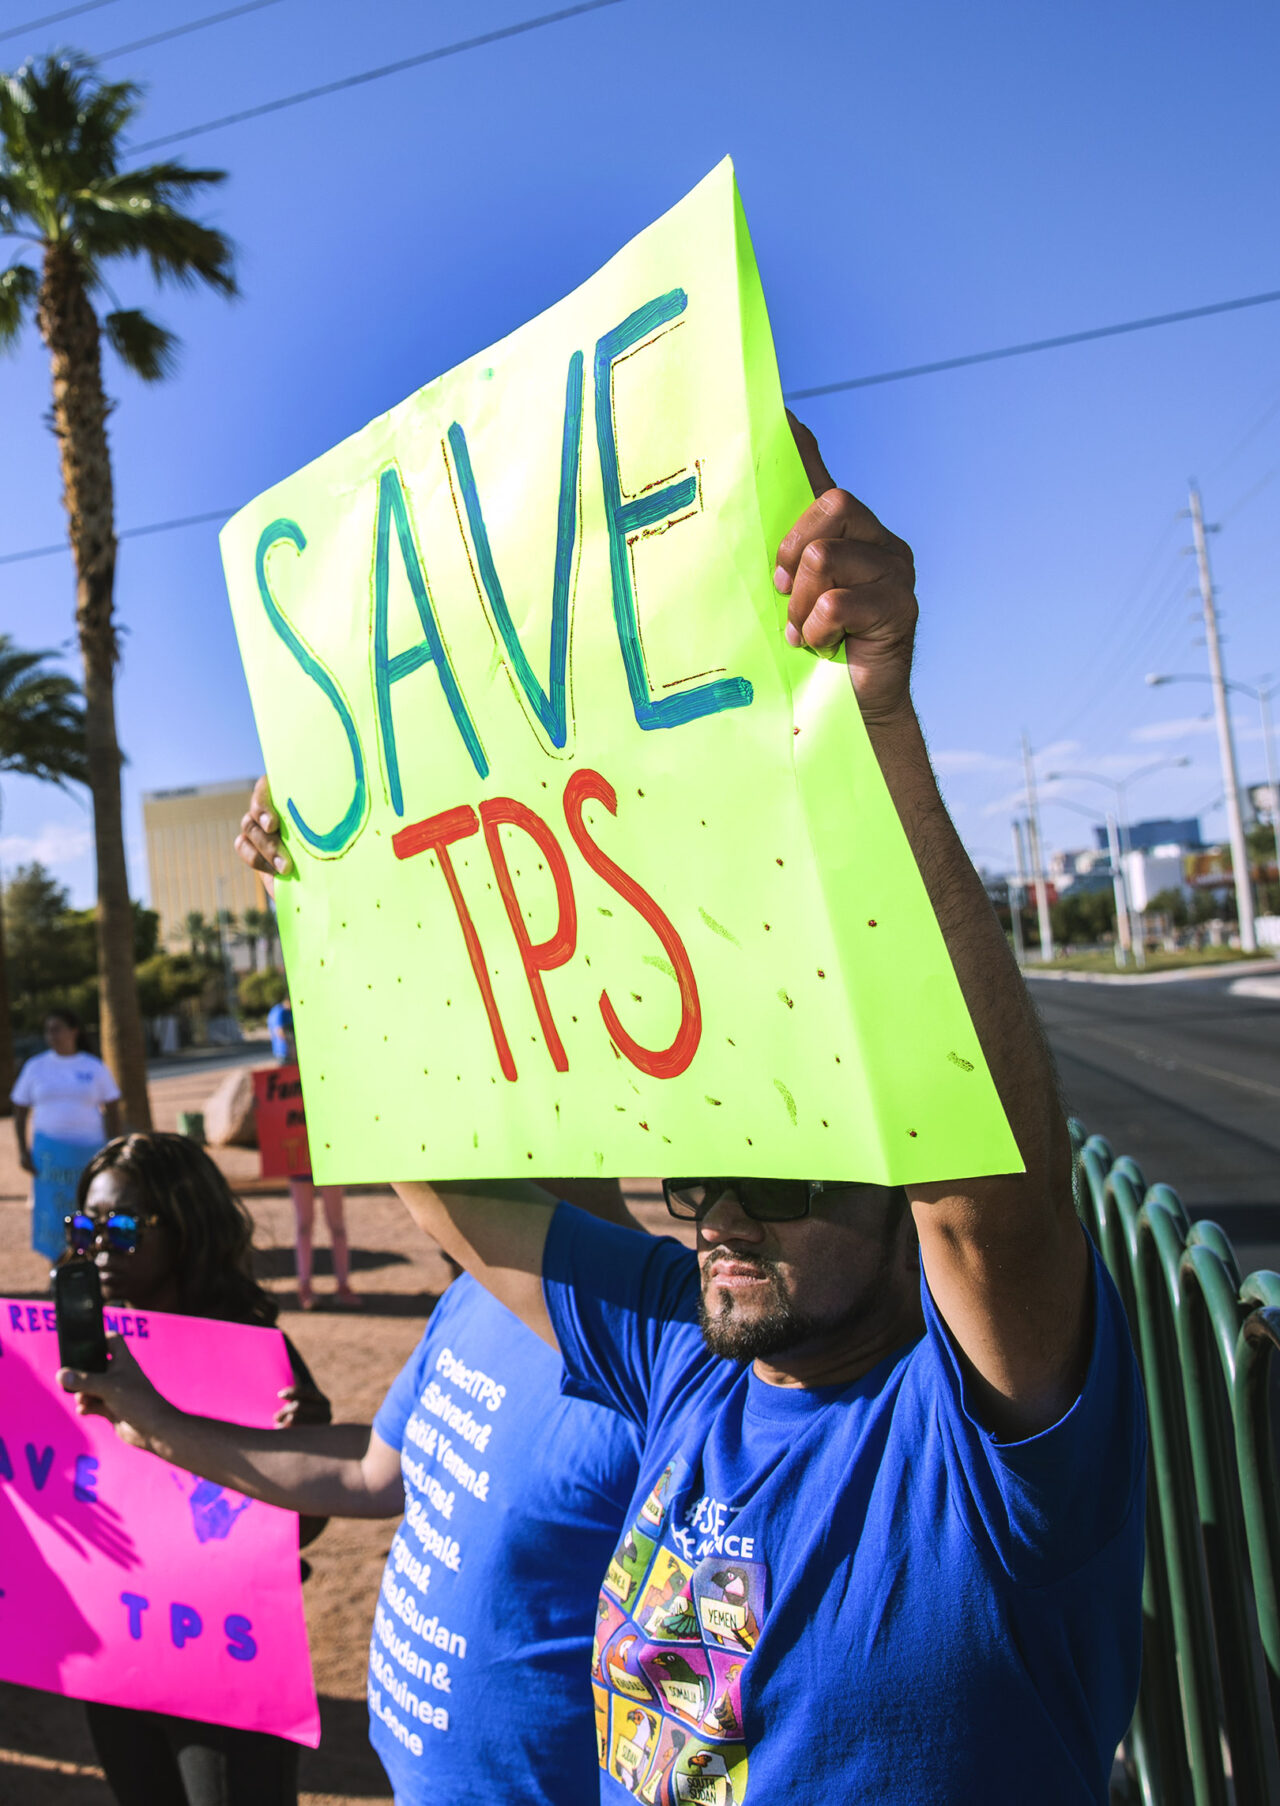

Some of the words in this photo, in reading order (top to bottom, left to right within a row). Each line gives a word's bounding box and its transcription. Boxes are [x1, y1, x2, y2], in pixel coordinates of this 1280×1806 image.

[254, 287, 754, 856] SAVE
[391, 768, 703, 1081] TPS
[120, 1592, 258, 1662] TPS
[707, 1607, 738, 1629] YEMEN
[689, 1789, 717, 1805] SUDAN
